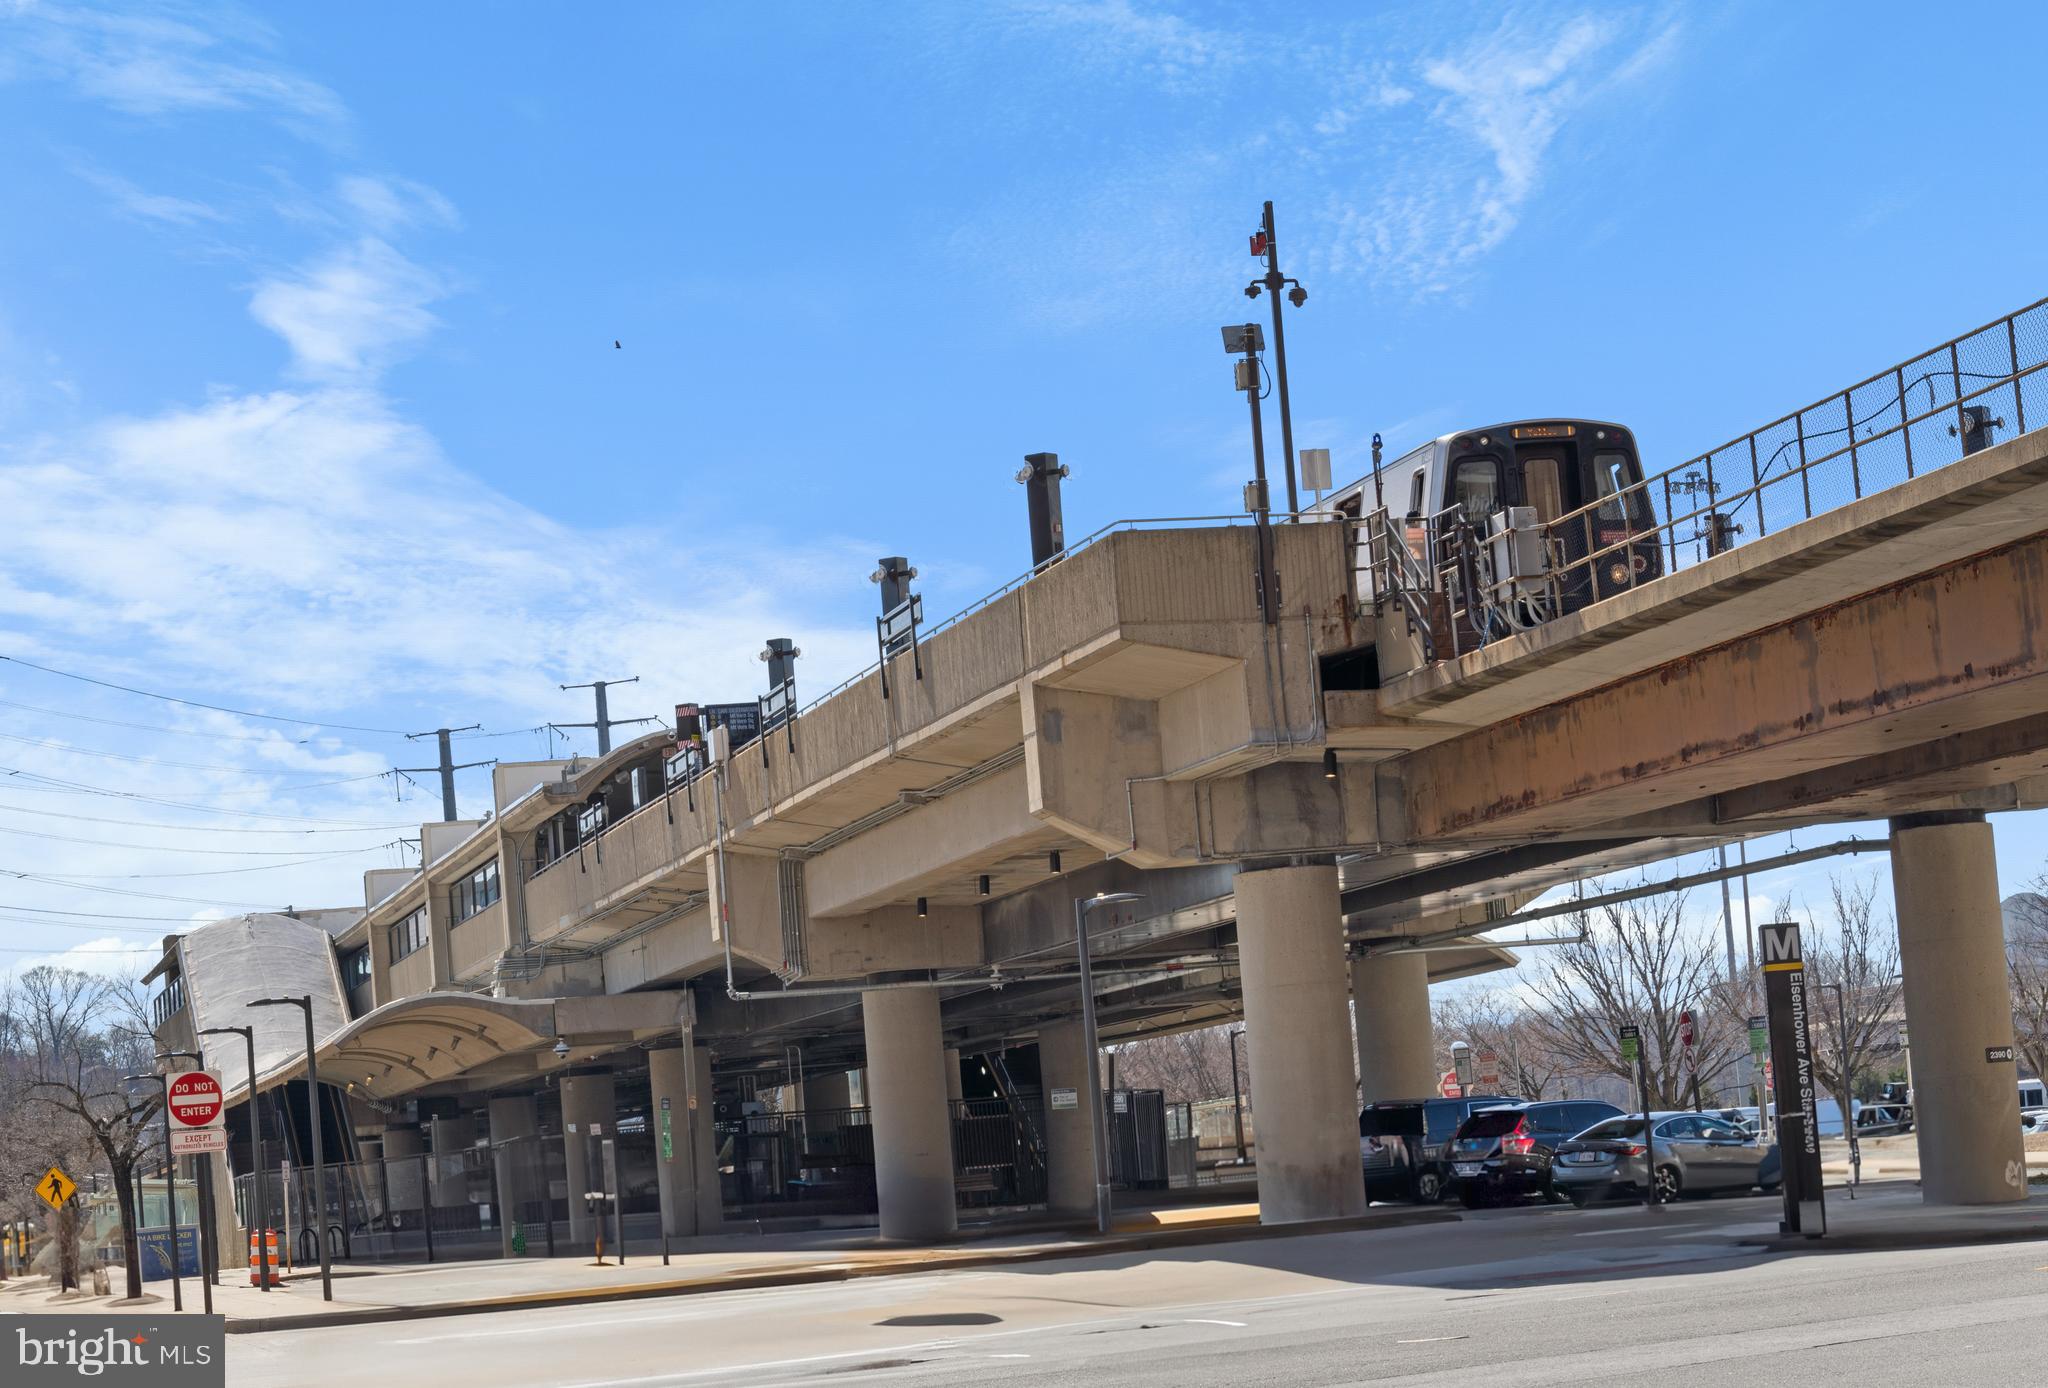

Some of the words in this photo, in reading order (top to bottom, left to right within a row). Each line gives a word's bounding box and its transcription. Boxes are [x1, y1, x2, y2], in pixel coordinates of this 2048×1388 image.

[1764, 926, 1800, 960] M
[1790, 972, 1806, 1055] Eisenhower
[1798, 1058, 1810, 1084] Ave
[1990, 1050, 2006, 1059] 2390
[175, 1084, 189, 1093] DO
[194, 1081, 214, 1092] NOT
[181, 1105, 212, 1117] ENTER
[185, 1133, 212, 1143] EXCEPT
[152, 1233, 166, 1241] BIKE
[167, 1231, 192, 1240] LCKER
